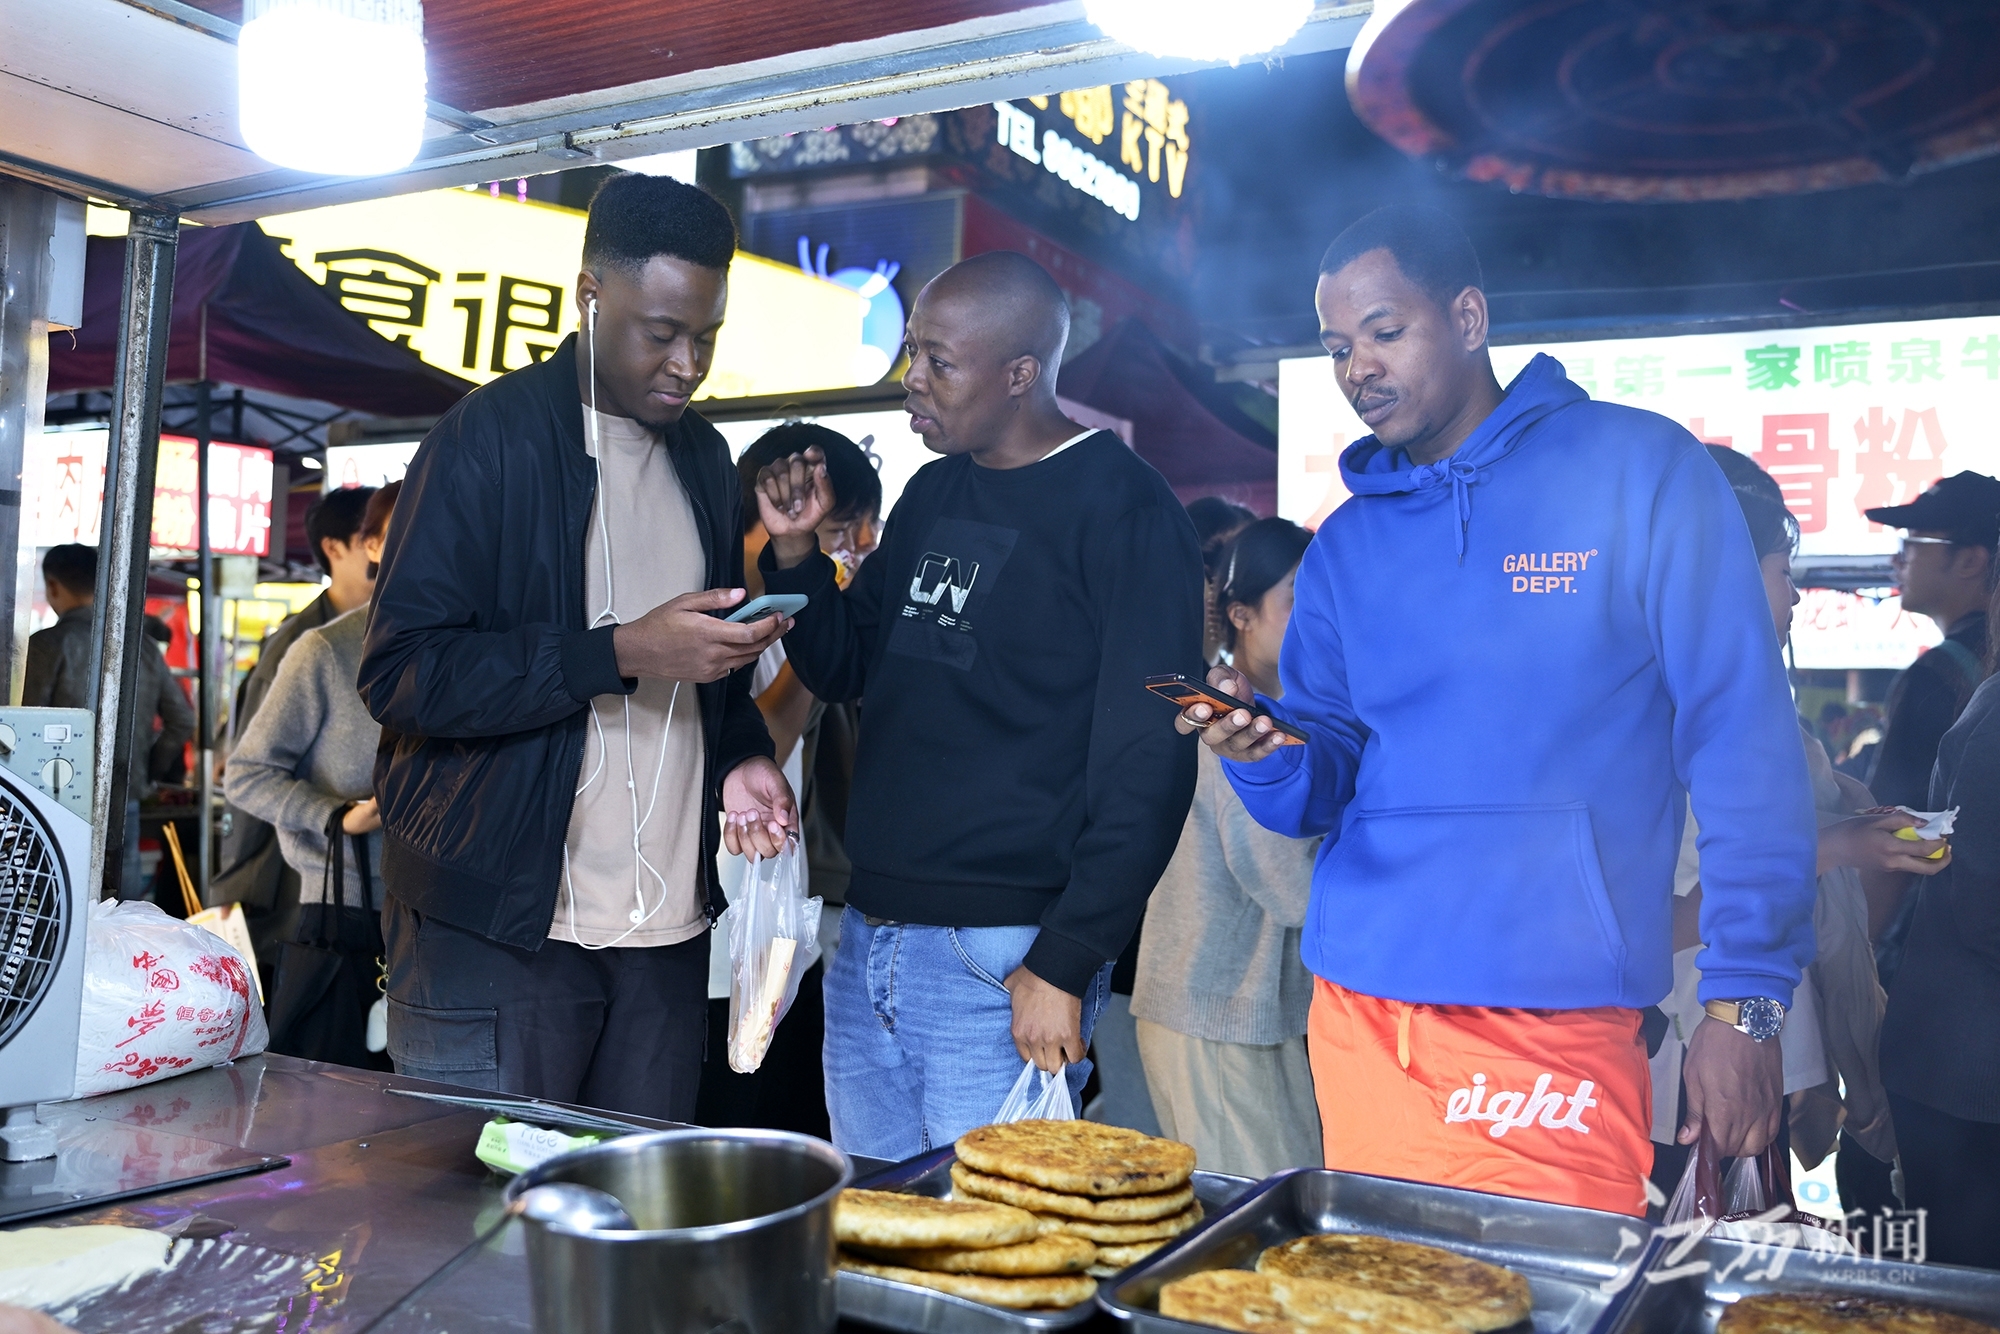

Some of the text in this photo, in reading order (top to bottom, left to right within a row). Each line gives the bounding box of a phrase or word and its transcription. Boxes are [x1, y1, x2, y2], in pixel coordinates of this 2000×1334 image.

[993, 100, 1041, 165] TEL
[1121, 111, 1188, 198] KTV
[1512, 576, 1577, 594] DEPT.
[1445, 1072, 1597, 1138] eight
